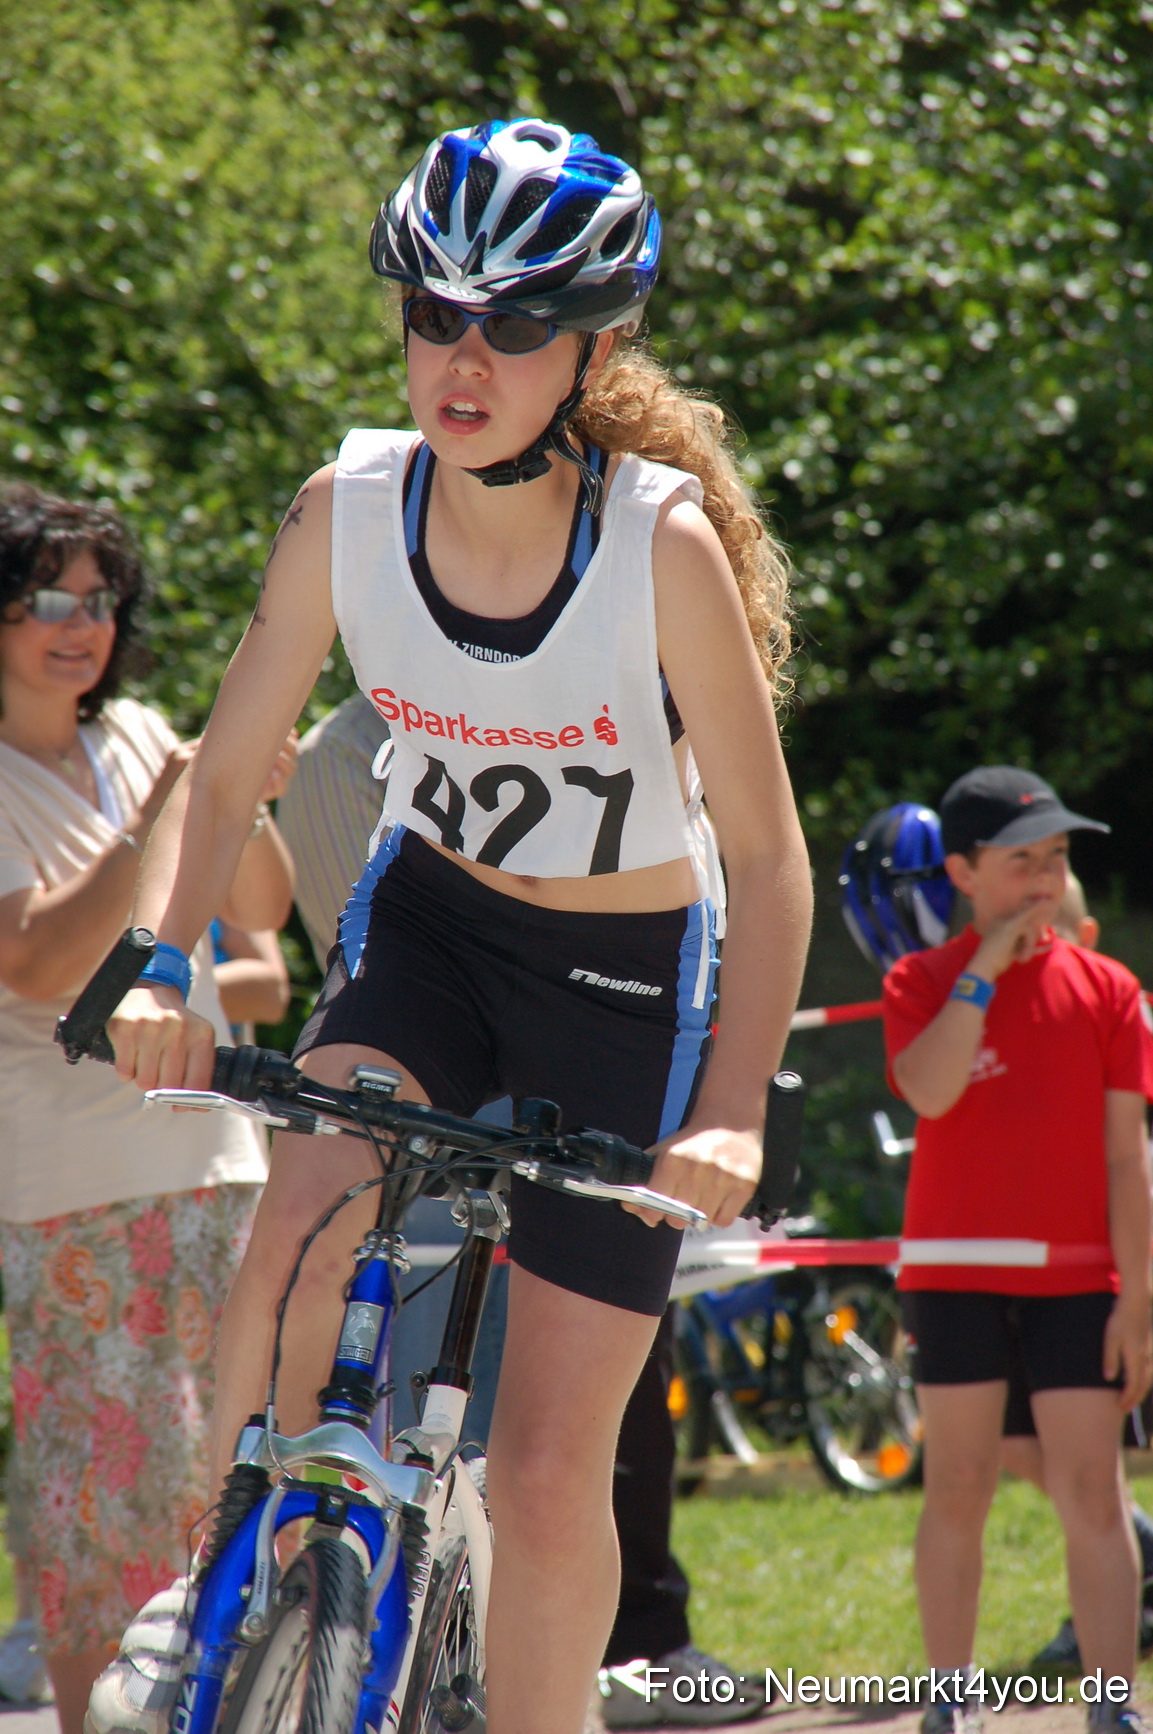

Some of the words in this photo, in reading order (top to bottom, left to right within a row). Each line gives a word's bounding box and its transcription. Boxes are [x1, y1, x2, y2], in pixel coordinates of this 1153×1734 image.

[371, 688, 584, 750] Sparkasse
[411, 753, 635, 877] 427
[568, 968, 663, 996] newline
